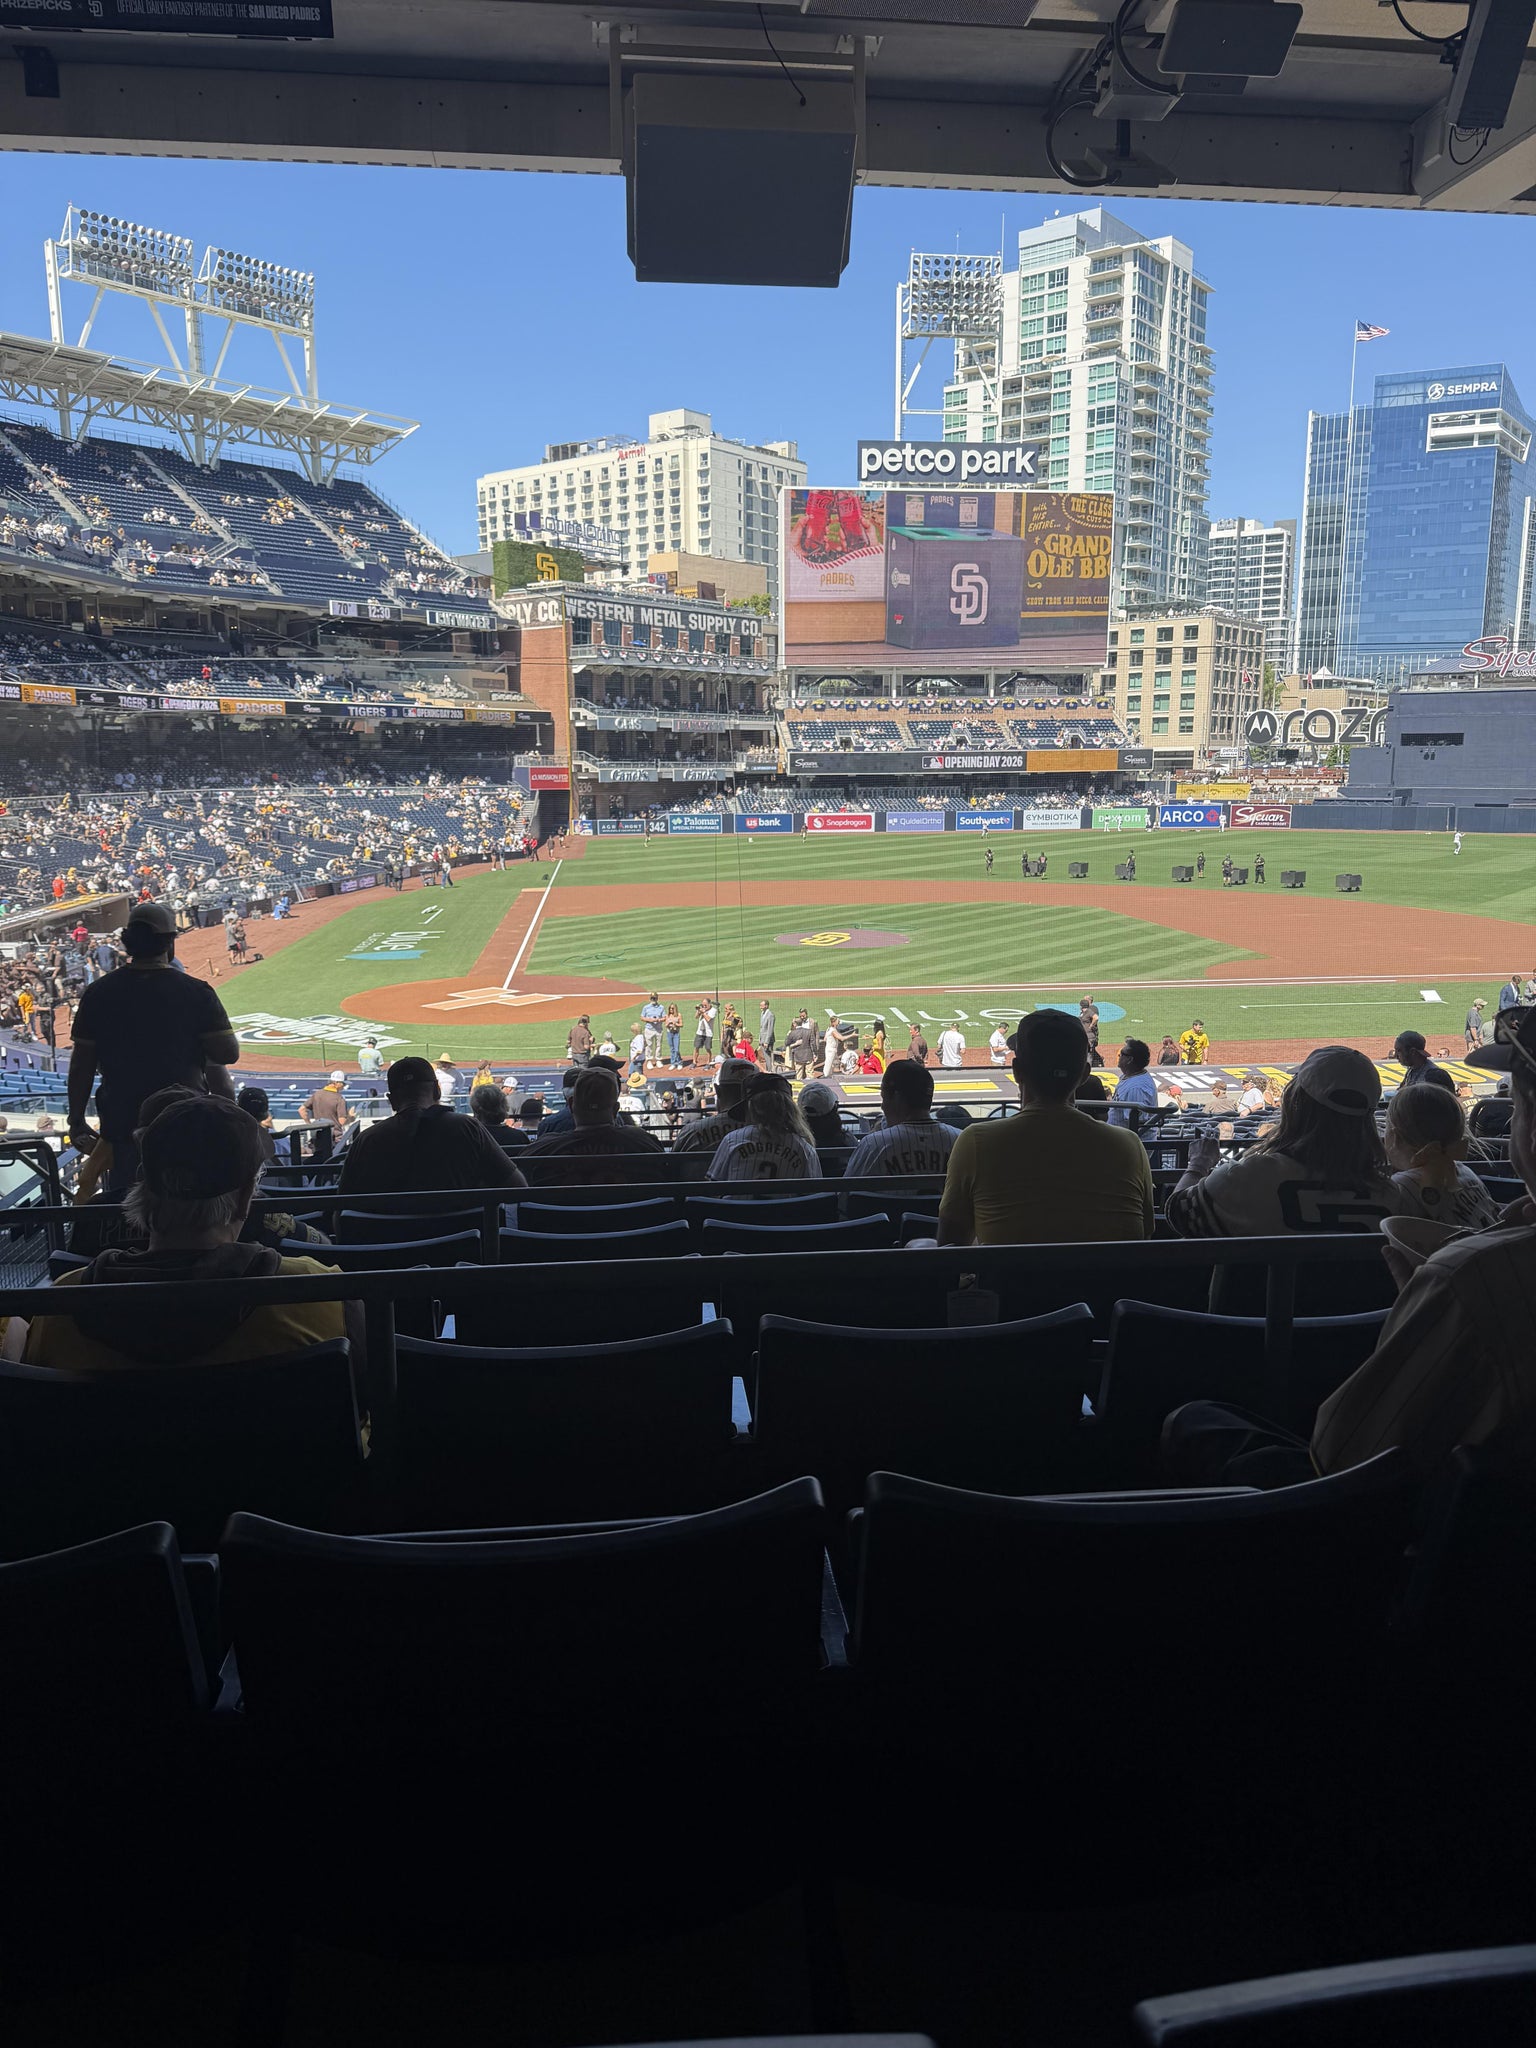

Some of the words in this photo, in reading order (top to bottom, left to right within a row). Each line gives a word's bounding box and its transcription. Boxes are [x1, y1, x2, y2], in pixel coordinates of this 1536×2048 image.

[235, 4, 248, 18] THE
[249, 5, 265, 19] SAN
[266, 6, 289, 19] DIEGO
[290, 7, 320, 21] PADRES
[1447, 381, 1498, 395] SEMPRA
[861, 443, 955, 480] petco
[961, 447, 1035, 480] park
[930, 495, 954, 507] PADRES
[1071, 497, 1086, 513] THE
[1032, 511, 1047, 521] HIS
[1043, 533, 1112, 557] GRAND
[1079, 556, 1111, 579] BB
[820, 572, 855, 587] PADRES
[565, 597, 634, 623] WESTERN
[640, 607, 686, 629] METAL
[689, 613, 736, 634] SUPPLY
[741, 619, 761, 637] CO.
[33, 689, 72, 705] PADRES
[118, 695, 147, 711] TIGERS
[235, 702, 283, 714] PADRES
[347, 706, 387, 717] TIGERS
[476, 710, 511, 721] PADRES
[944, 756, 984, 769] OPENING
[983, 756, 1001, 768] DAY
[1001, 756, 1023, 768] 2026
[683, 817, 719, 826] Palomar
[758, 818, 781, 827] bank
[900, 817, 943, 825] QuidelOrtho
[960, 816, 1004, 825] Southwest
[1161, 811, 1204, 823] ARCO
[1235, 806, 1285, 826] Sycuan
[649, 821, 666, 833] 342
[826, 819, 867, 827] Snapdragon
[824, 1006, 1031, 1024] blue
[738, 1142, 802, 1169] BOGAERTS
